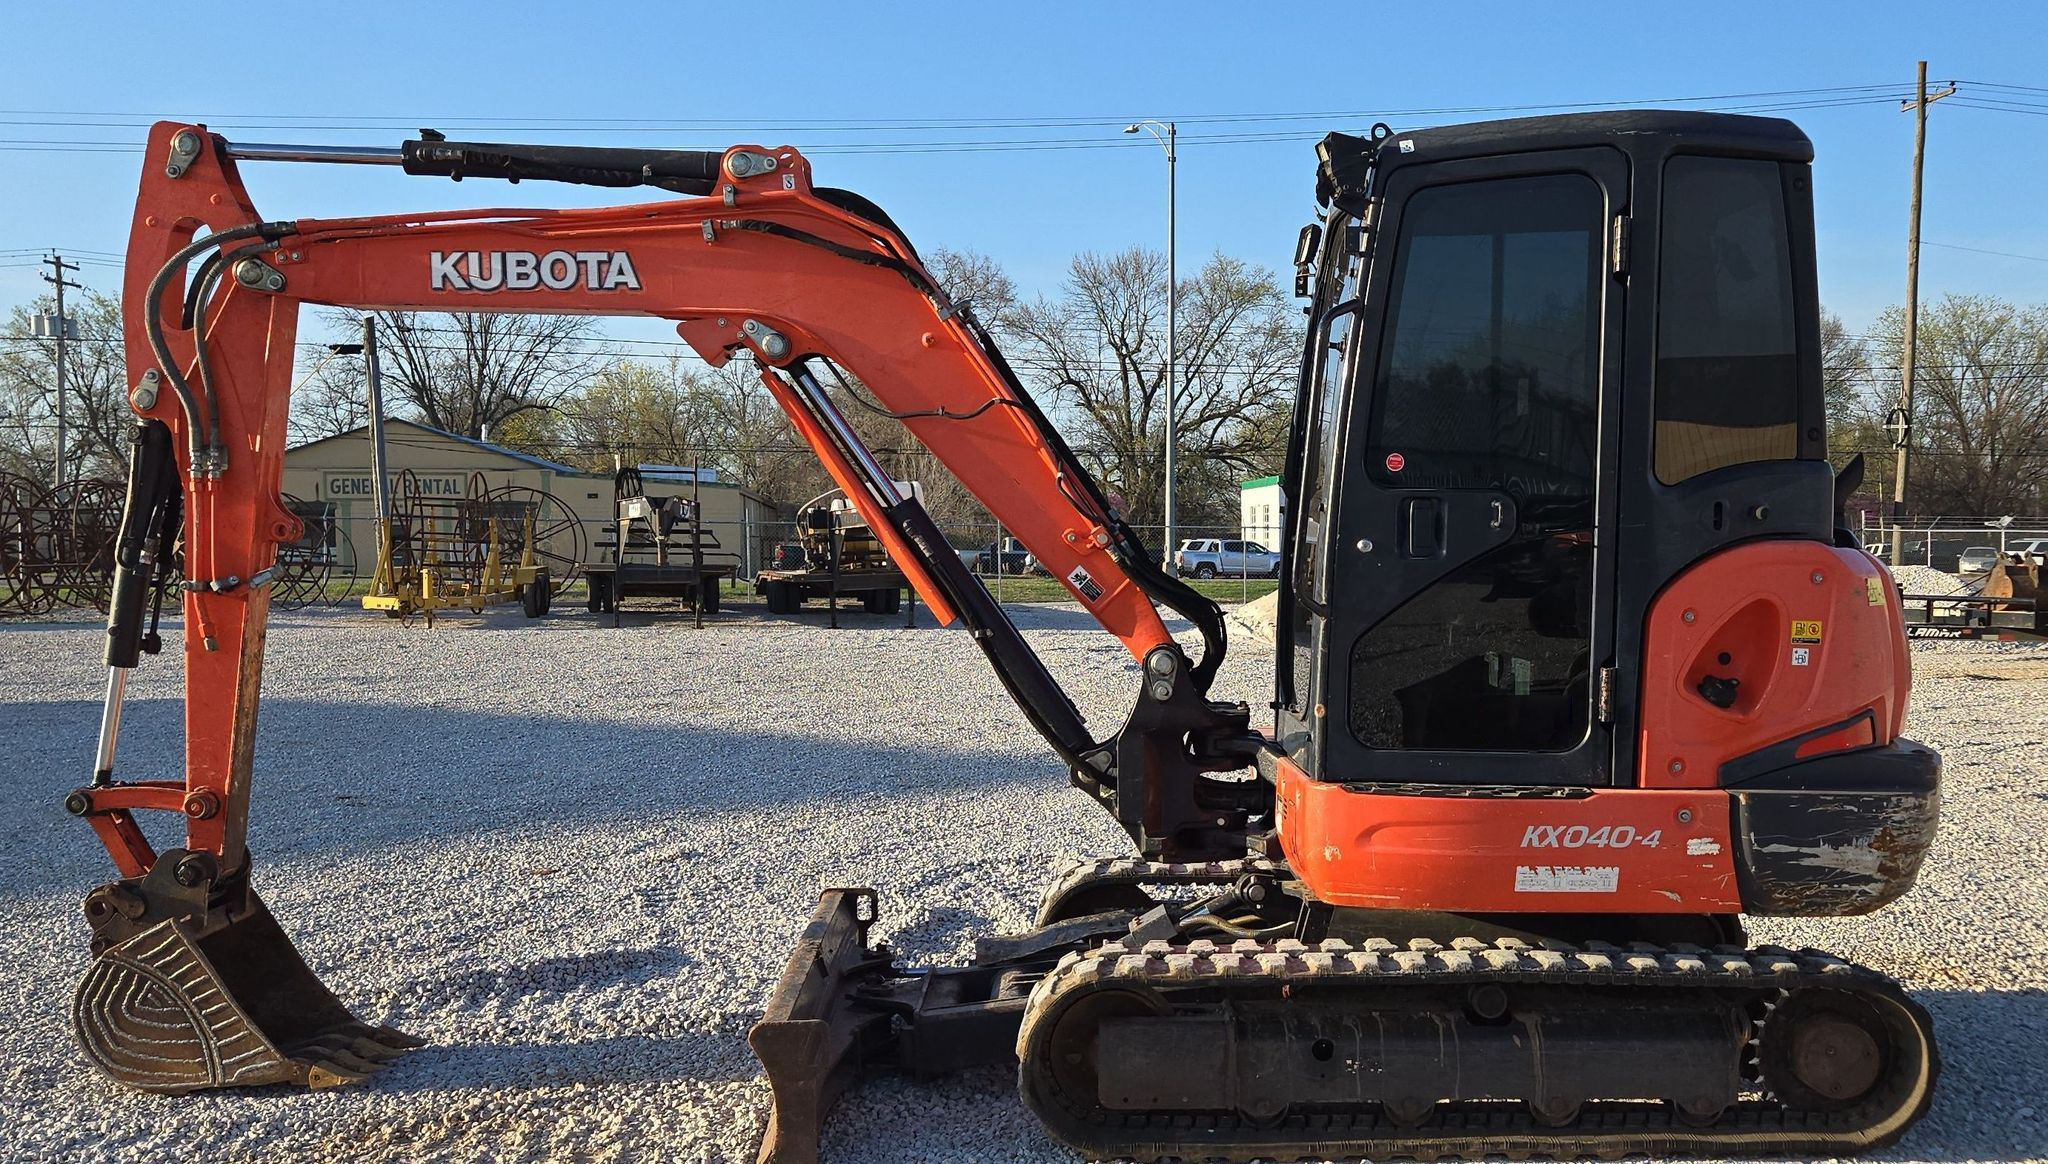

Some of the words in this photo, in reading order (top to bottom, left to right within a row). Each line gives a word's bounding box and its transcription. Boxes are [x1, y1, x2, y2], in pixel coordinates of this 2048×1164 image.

[429, 250, 642, 291] KUBOTA
[330, 478, 398, 495] GENEL
[1520, 825, 1662, 848] KX040-4
